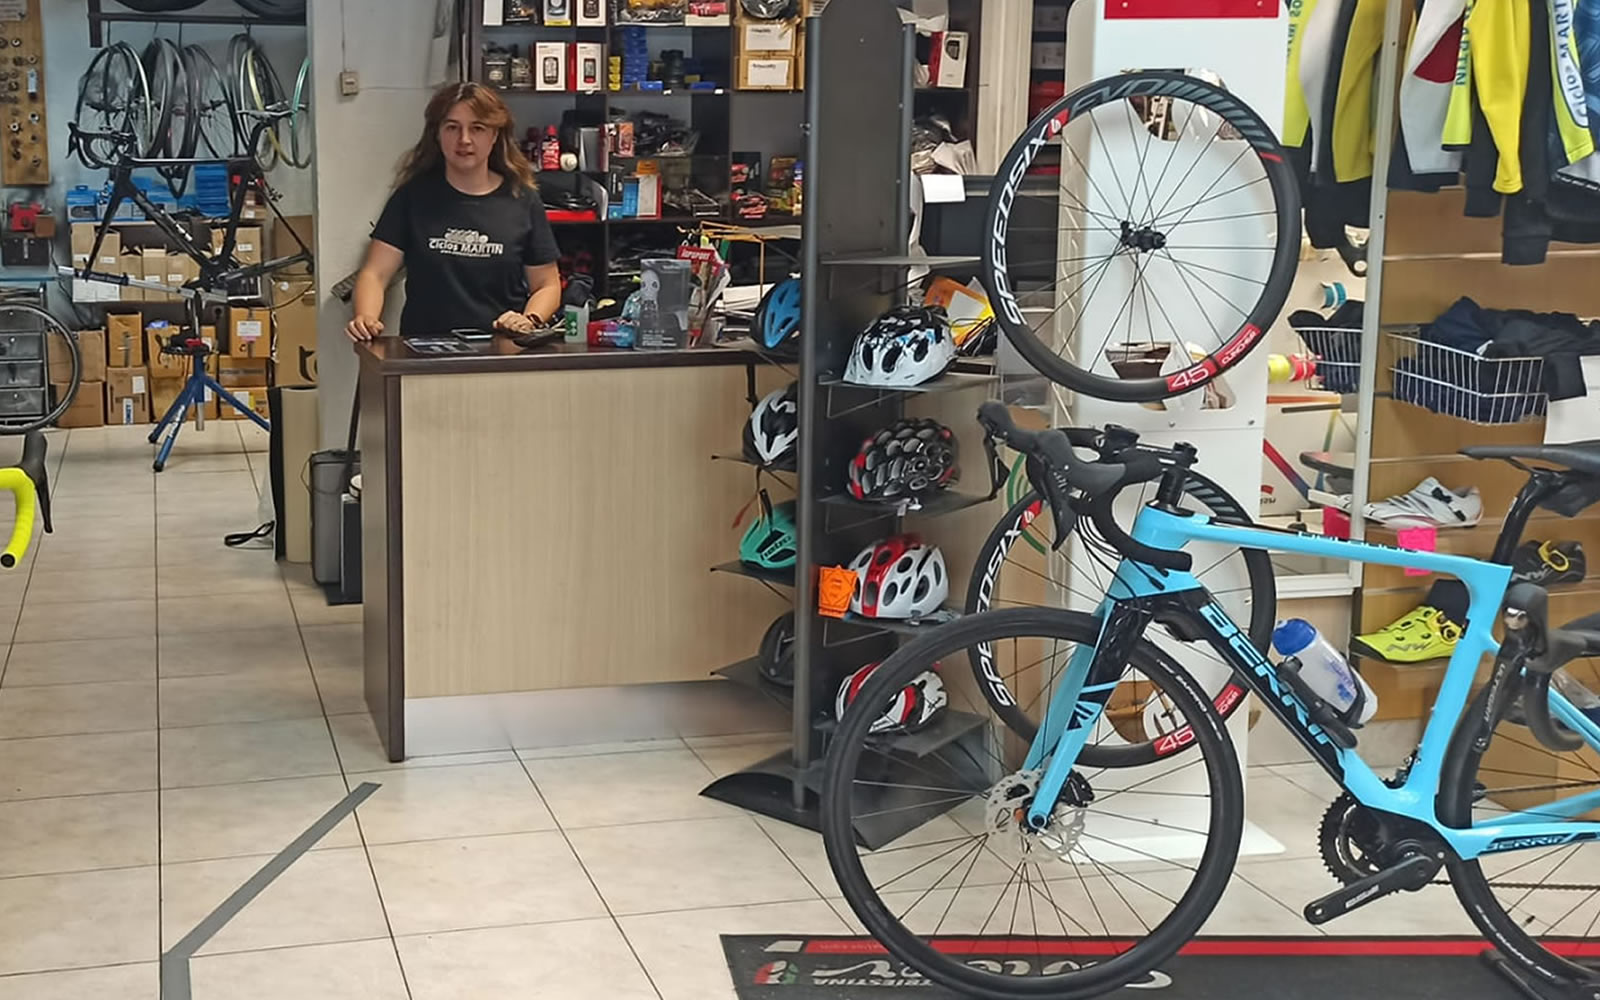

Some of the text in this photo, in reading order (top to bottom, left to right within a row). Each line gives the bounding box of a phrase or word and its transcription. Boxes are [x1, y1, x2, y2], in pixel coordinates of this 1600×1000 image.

[1071, 79, 1161, 117] EVO
[992, 123, 1051, 326] SPEEDSIX
[460, 242, 503, 255] MARTIN
[1170, 363, 1209, 391] 45
[1158, 725, 1196, 753] 45
